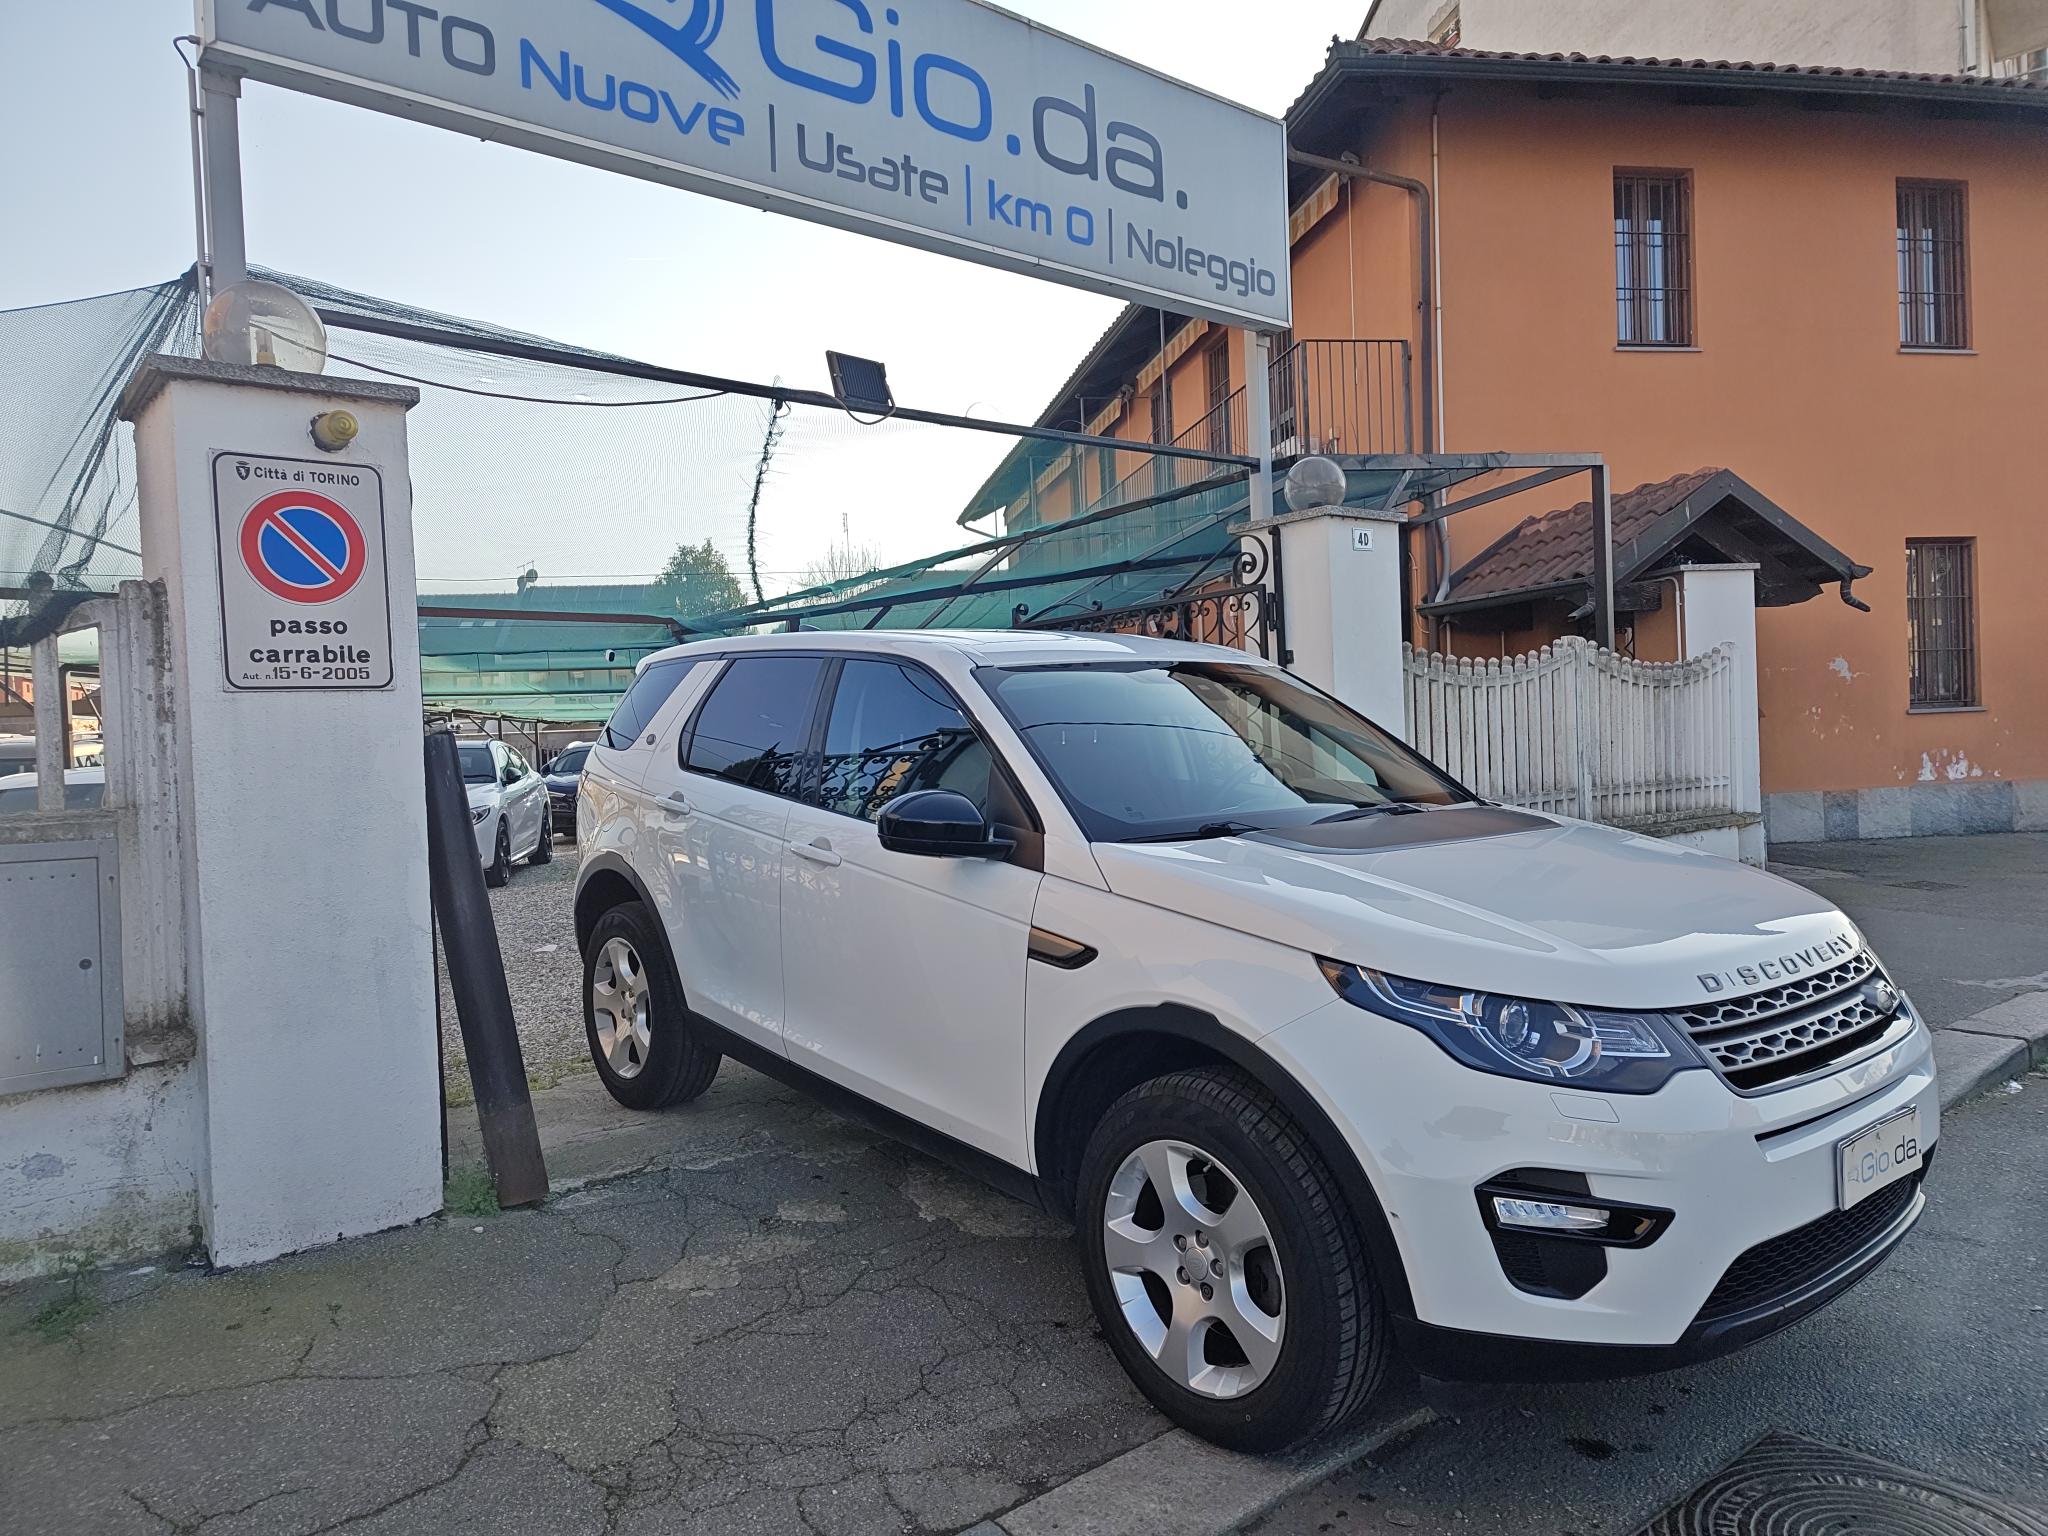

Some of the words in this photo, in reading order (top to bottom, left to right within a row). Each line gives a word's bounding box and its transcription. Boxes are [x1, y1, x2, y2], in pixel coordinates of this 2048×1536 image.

[519, 37, 745, 146] Nuove
[796, 123, 949, 204] Usate
[987, 179, 1052, 236] km
[1126, 221, 1276, 297] Noleggio
[253, 466, 287, 481] Città
[293, 471, 305, 482] di
[309, 472, 360, 486] TORINO
[270, 618, 348, 637] passo
[249, 645, 371, 664] carrabile
[242, 673, 263, 681] Aut.
[1696, 933, 1853, 994] DISCOVERY
